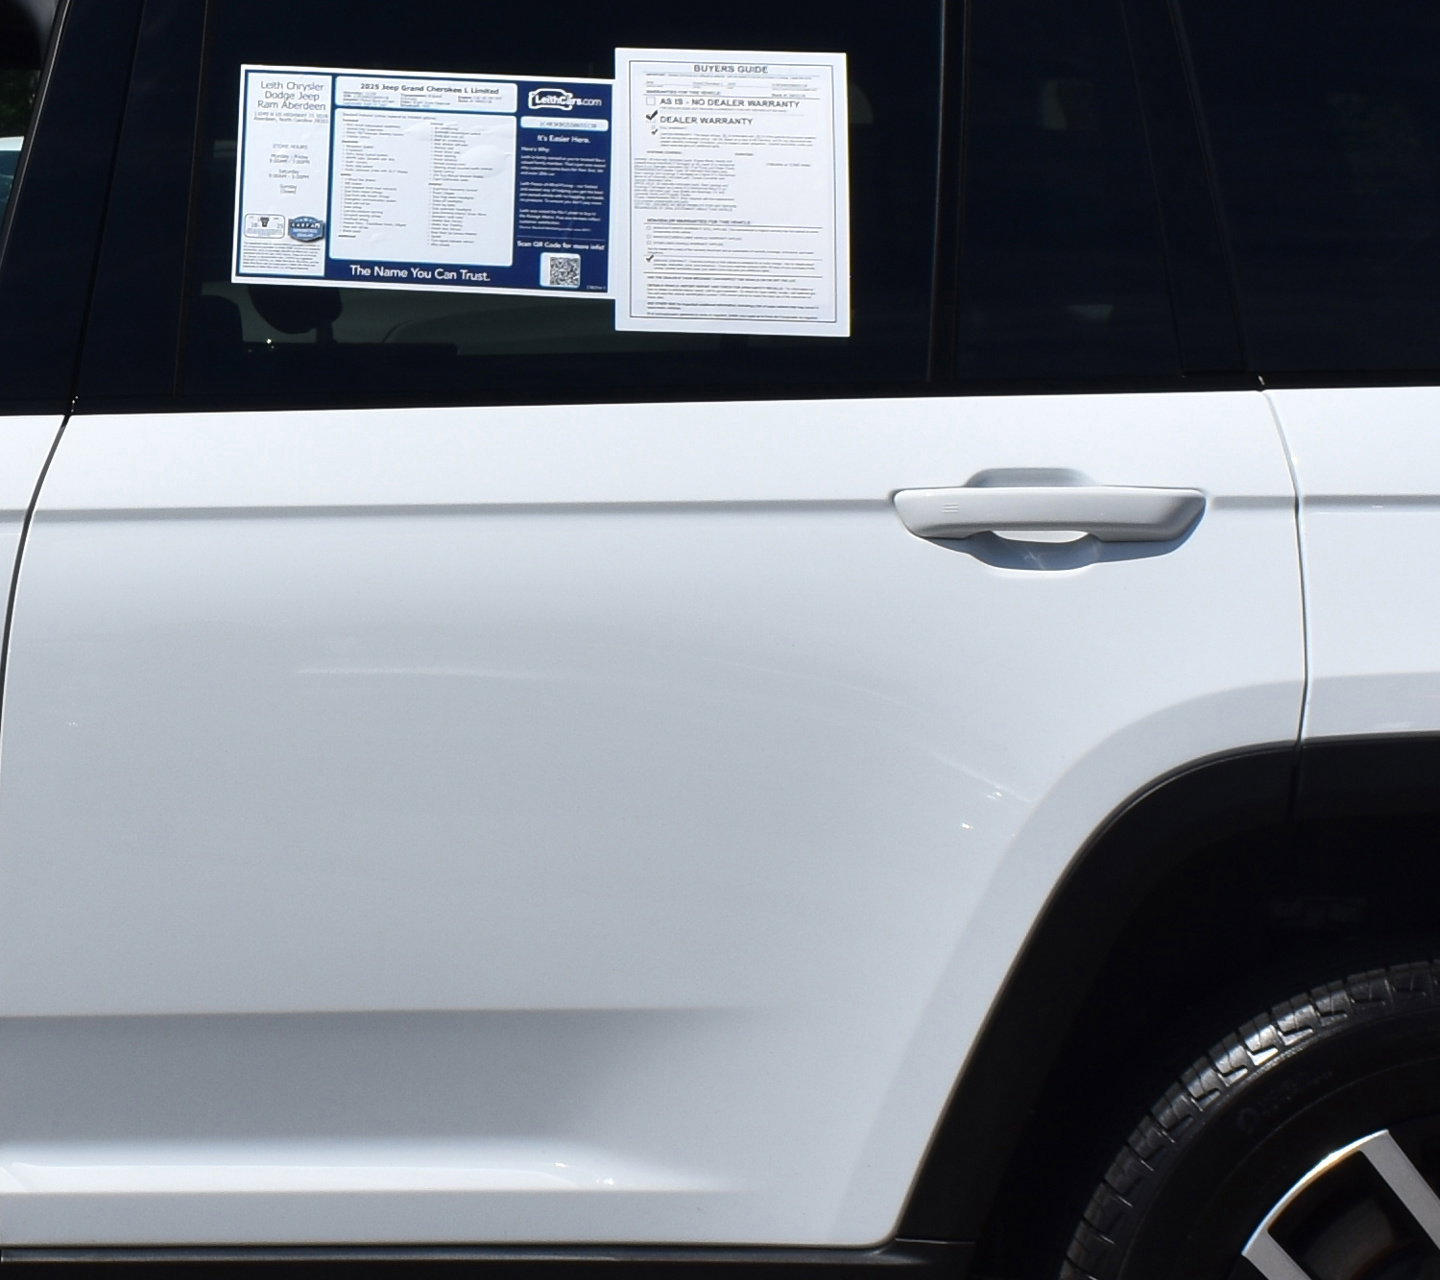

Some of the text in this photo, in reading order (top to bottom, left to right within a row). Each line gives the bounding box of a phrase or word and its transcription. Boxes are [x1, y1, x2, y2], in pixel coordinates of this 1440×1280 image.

[694, 64, 768, 73] BUYERS GUIDE
[260, 80, 324, 91] Leith Chrysler
[401, 84, 424, 92] Grand
[265, 91, 320, 102] Dodge Jeep
[257, 100, 326, 110] Ram Aberdeen
[692, 98, 705, 106] NO
[708, 99, 744, 107] DEALER
[747, 100, 800, 108] WARRANTY
[700, 117, 753, 125] WARRANTY
[349, 265, 491, 281] The Name You Can Trust.
